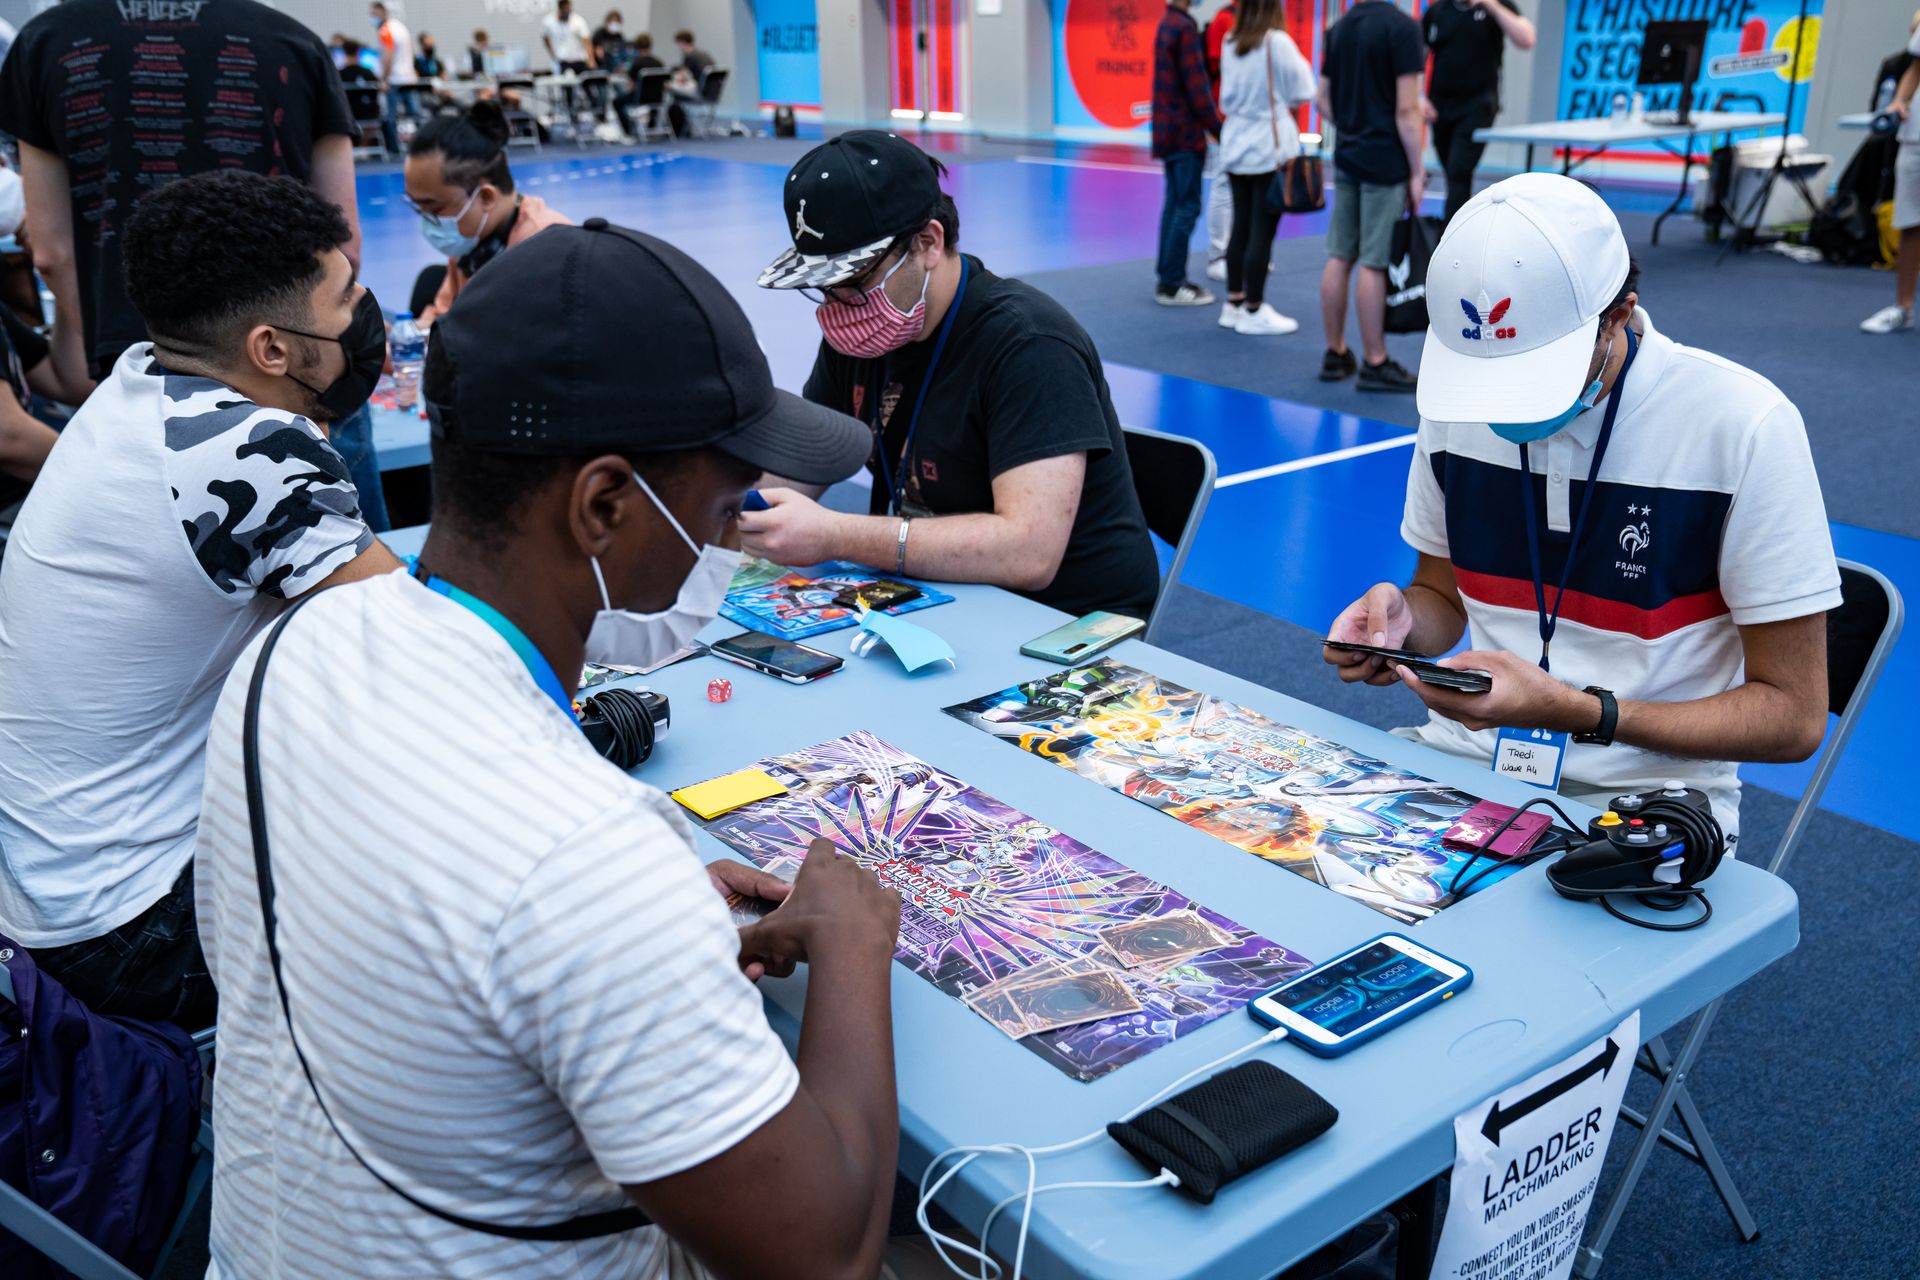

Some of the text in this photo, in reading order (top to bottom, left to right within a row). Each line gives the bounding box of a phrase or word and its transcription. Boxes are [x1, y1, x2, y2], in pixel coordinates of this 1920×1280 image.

[1462, 326, 1517, 340] adidas
[1615, 561, 1647, 575] FRANCE
[1623, 571, 1639, 579] FFF
[1482, 1106, 1602, 1205] LADDER
[1484, 1141, 1595, 1224] MATCHMAKING
[1460, 1242, 1504, 1276] CONNECT
[1507, 1229, 1522, 1252] YOU
[1524, 1221, 1536, 1240] ON
[1539, 1206, 1559, 1231] YOUR
[1561, 1185, 1587, 1216] SMASH
[1489, 1242, 1529, 1280] ULTIMATE
[1531, 1219, 1565, 1253] WANTED
[1531, 1241, 1557, 1270] EVENT
[1547, 1259, 1553, 1275] A
